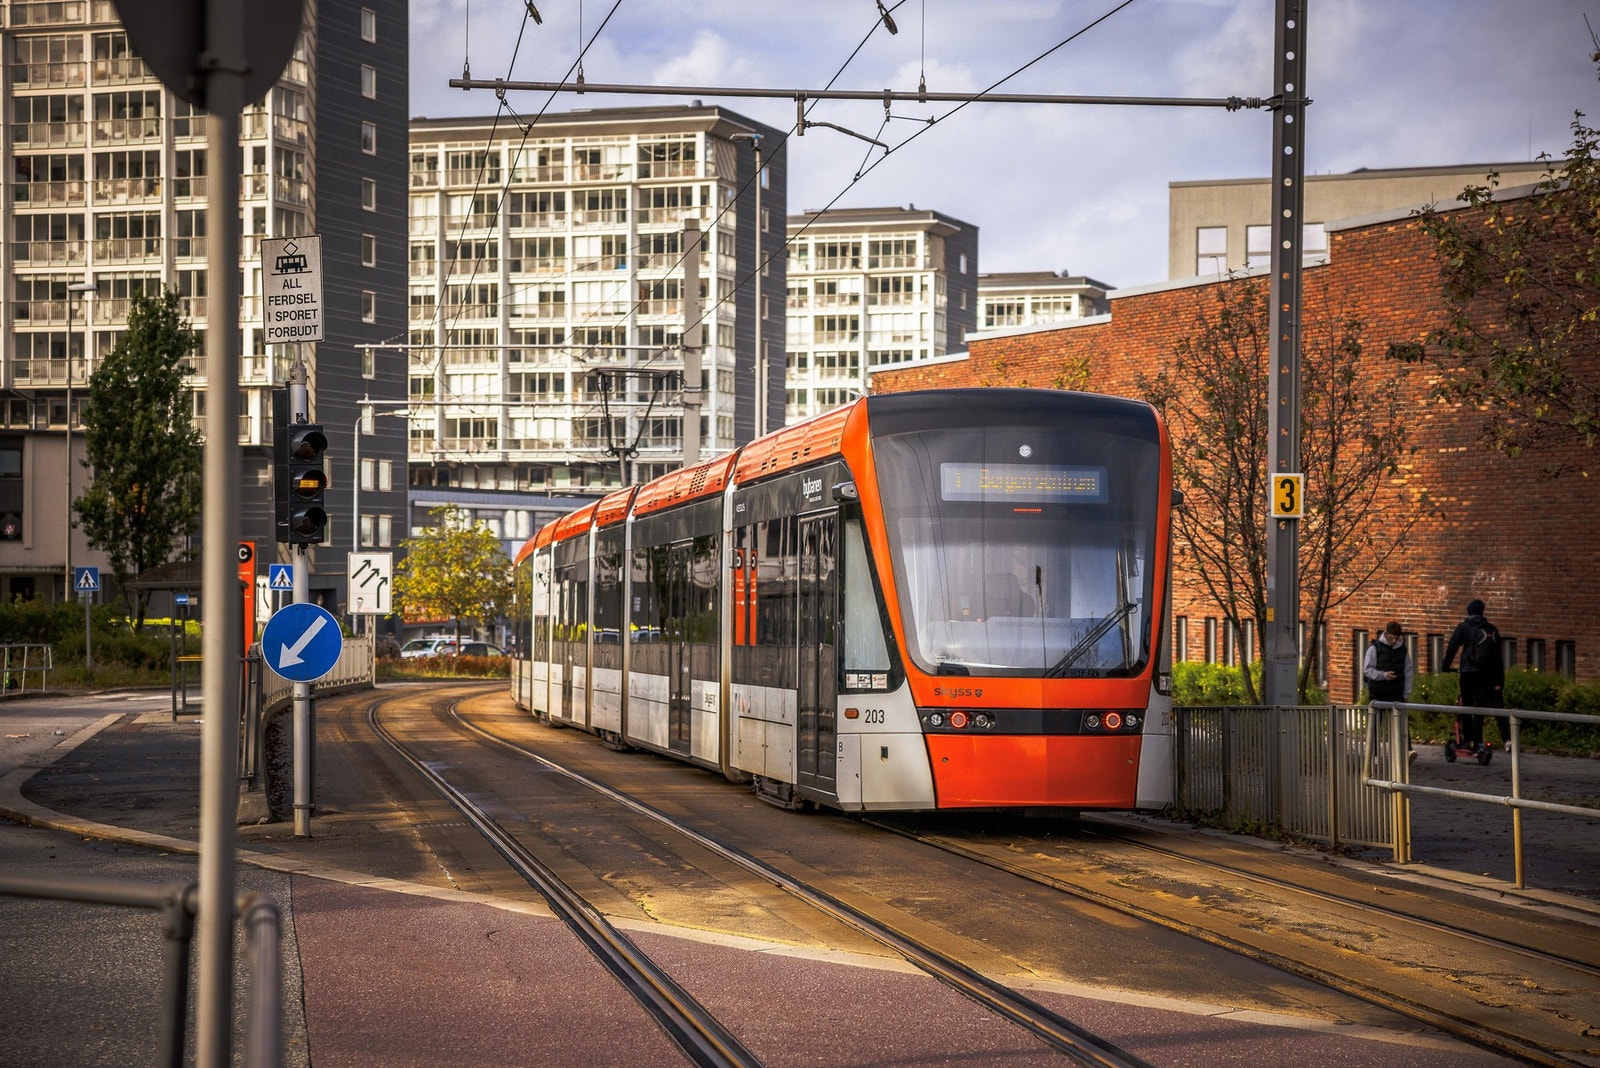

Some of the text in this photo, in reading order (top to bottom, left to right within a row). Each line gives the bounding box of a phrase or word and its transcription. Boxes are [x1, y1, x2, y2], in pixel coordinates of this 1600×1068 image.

[282, 278, 302, 290] ALL
[268, 293, 317, 306] FERDSEL
[267, 309, 318, 322] I SPORET
[268, 325, 319, 338] FORBUDT
[1280, 478, 1295, 513] 3
[238, 547, 249, 560] C
[864, 709, 885, 724] 203
[838, 741, 844, 752] B
